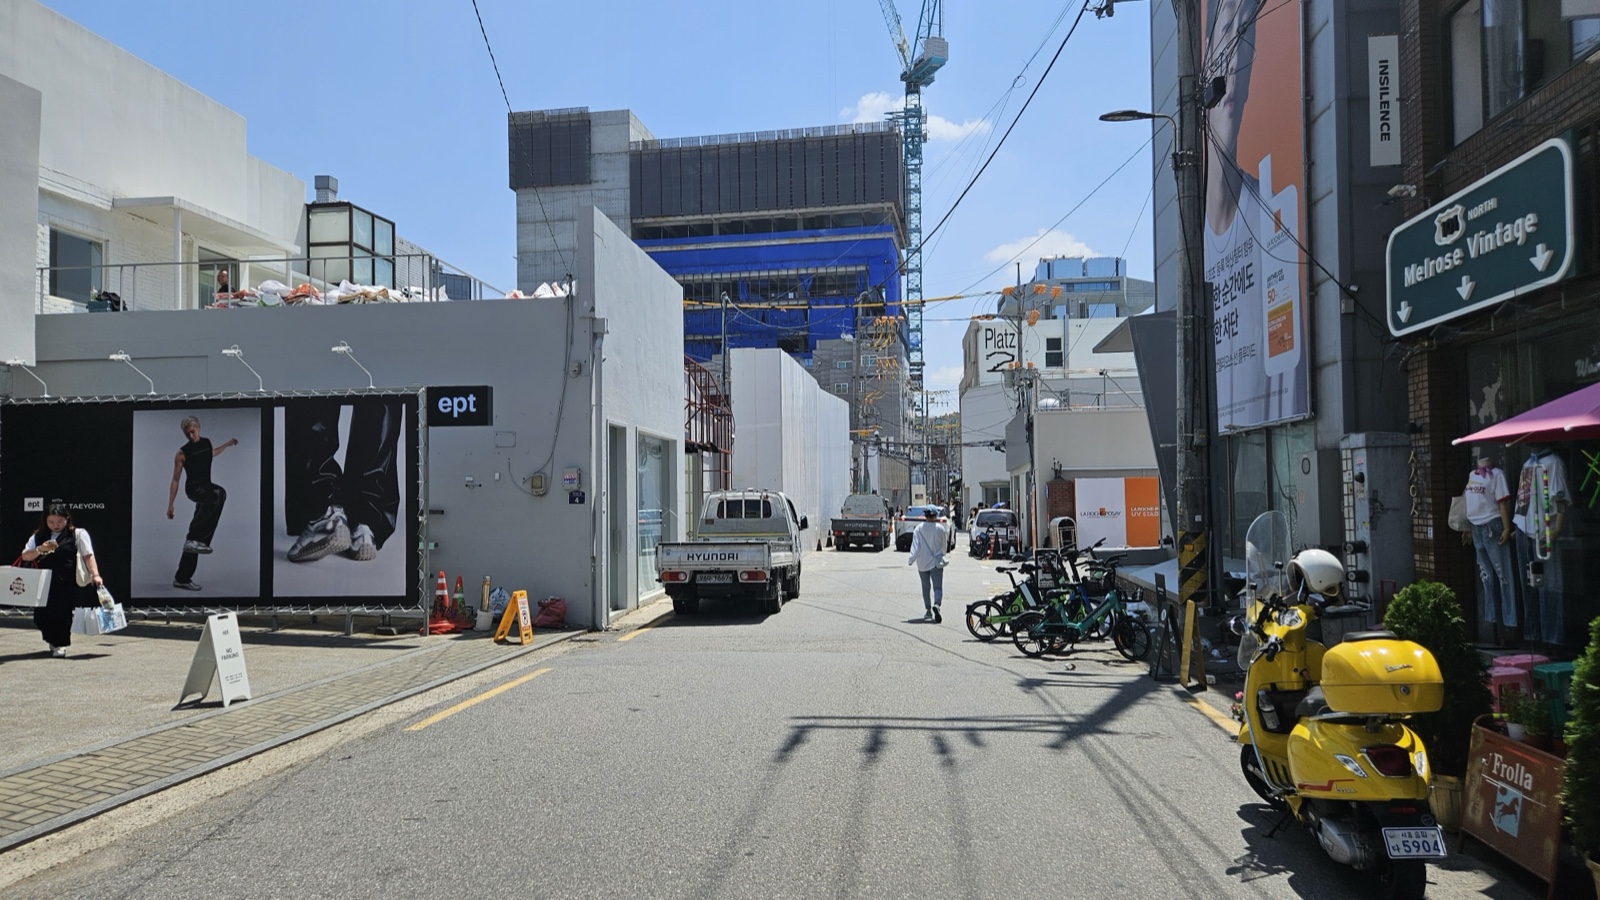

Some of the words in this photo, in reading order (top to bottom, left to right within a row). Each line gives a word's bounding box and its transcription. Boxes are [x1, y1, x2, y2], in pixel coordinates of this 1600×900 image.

[1378, 59, 1391, 142] INSILENCE
[1467, 198, 1497, 220] NORTH
[1404, 248, 1464, 288] Melrose
[1466, 213, 1538, 260] Vintage
[1222, 262, 1255, 307] 순간에도
[1223, 308, 1239, 340] 차단
[985, 327, 1016, 349] Platz
[437, 393, 477, 418] ept
[27, 500, 40, 509] ept
[687, 552, 739, 561] HYUNDAI
[221, 652, 239, 661] PARKING
[1491, 752, 1533, 791] Frolla
[1401, 839, 1441, 854] 5904
